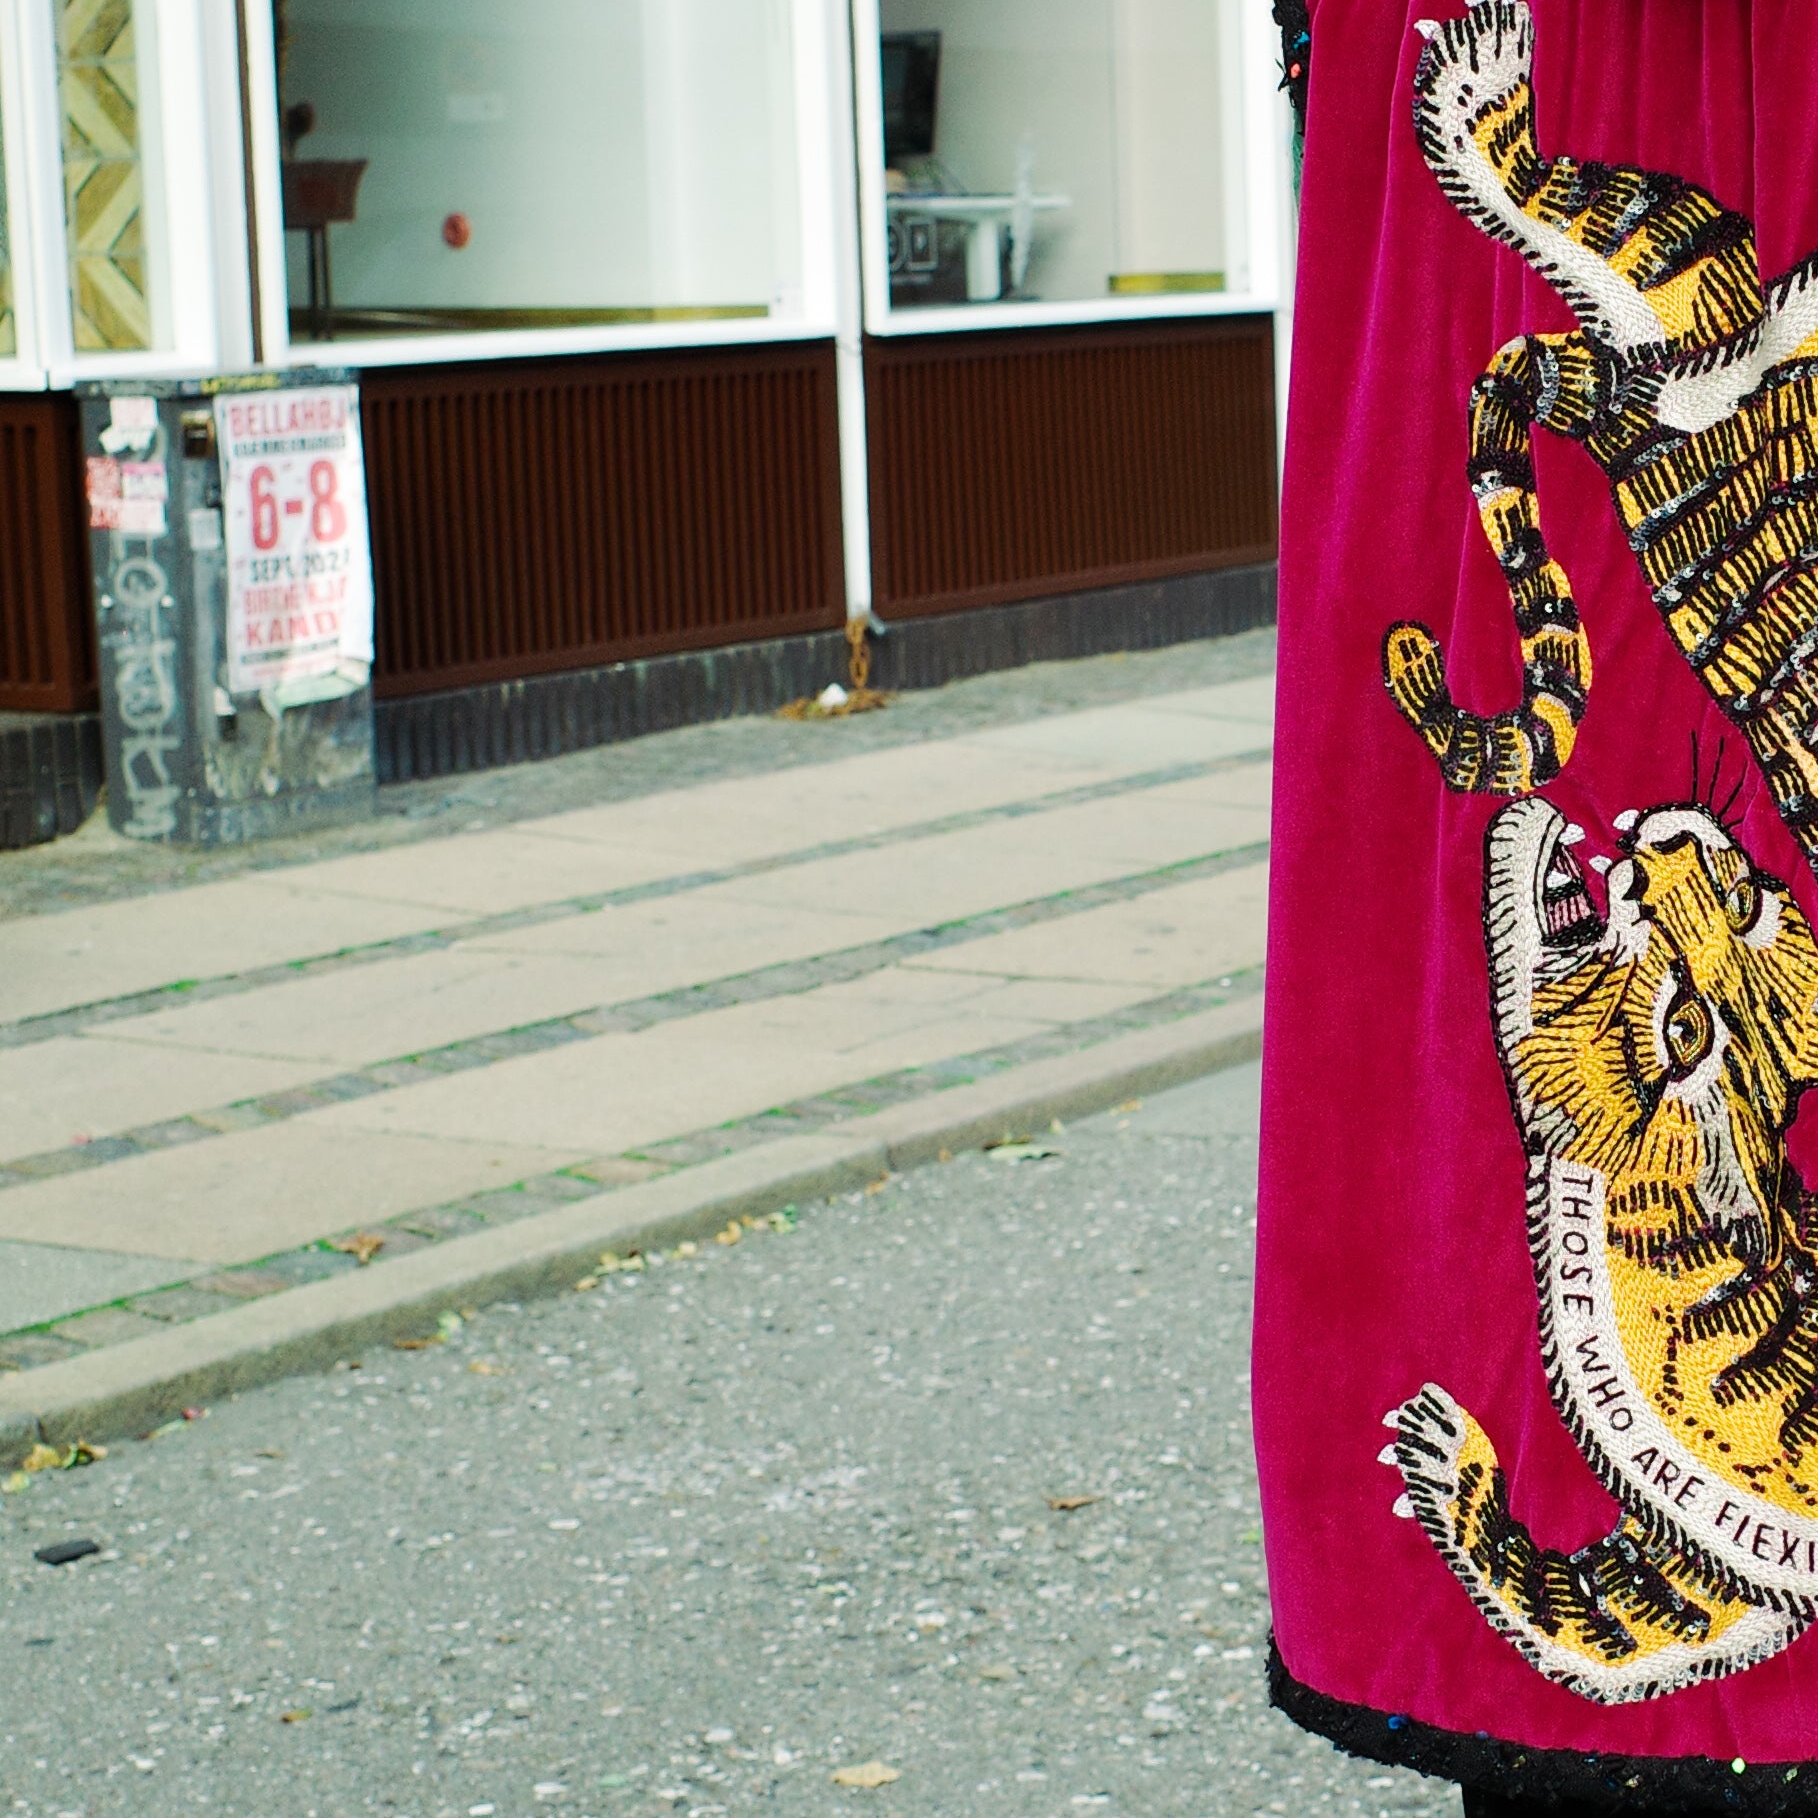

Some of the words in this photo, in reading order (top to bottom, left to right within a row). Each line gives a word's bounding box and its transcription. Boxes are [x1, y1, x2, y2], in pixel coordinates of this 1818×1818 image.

[250, 460, 348, 550] 6-8
[1561, 1173, 1595, 1316] THOSE
[1575, 1334, 1634, 1432] WHO
[1630, 1447, 1705, 1511] ARE
